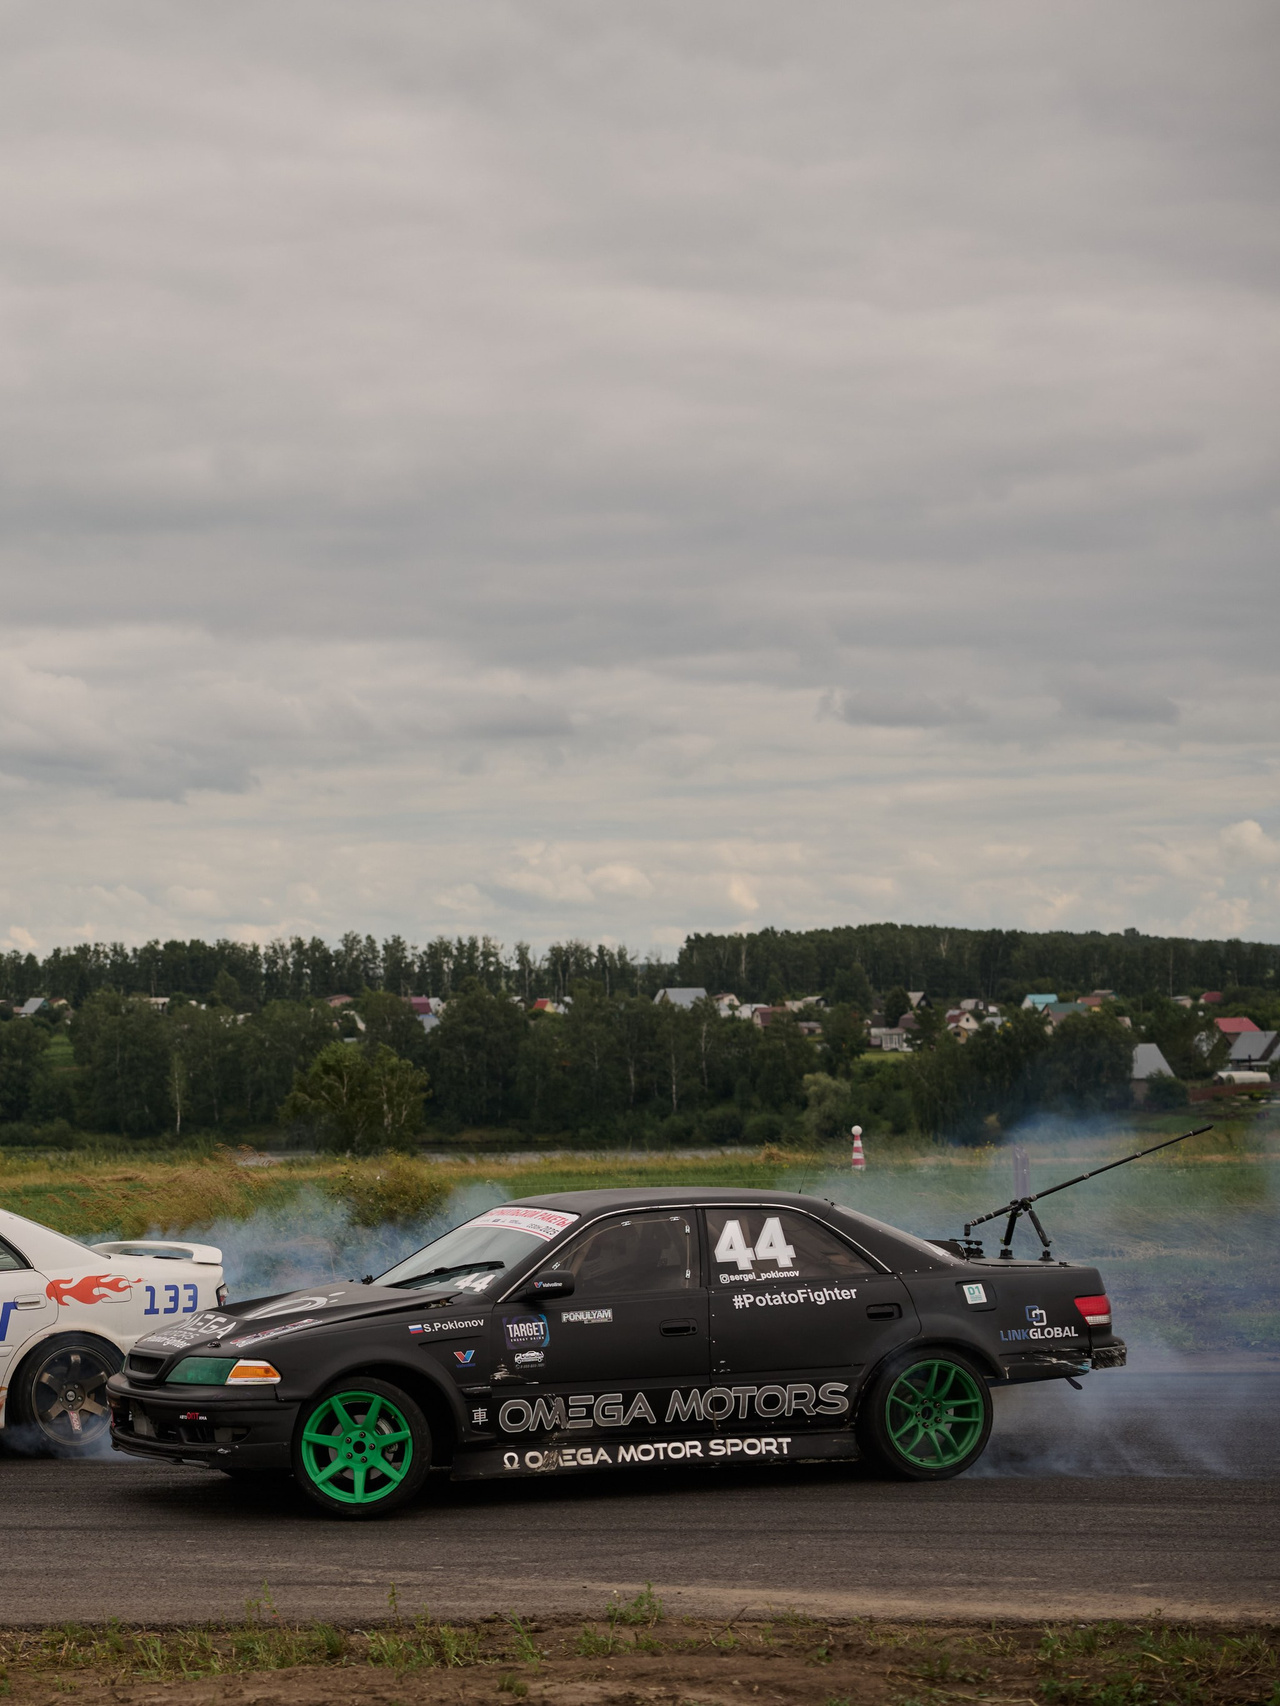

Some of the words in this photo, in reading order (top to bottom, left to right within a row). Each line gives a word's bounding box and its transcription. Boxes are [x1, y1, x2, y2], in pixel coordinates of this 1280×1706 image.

[714, 1216, 797, 1271] 44
[454, 1273, 496, 1293] 44
[967, 1285, 982, 1296] D1
[144, 1283, 199, 1315] 133
[732, 1287, 858, 1310] #PotatoFighter
[423, 1319, 485, 1333] S.Poklonov
[506, 1321, 545, 1338] TARGET
[1000, 1326, 1079, 1341] LINKGLOBAL
[471, 1407, 489, 1426] 車
[498, 1391, 657, 1433] OMEGA
[664, 1382, 850, 1423] MOTORS
[617, 1440, 705, 1464] MOTOR
[708, 1437, 792, 1457] SPORT
